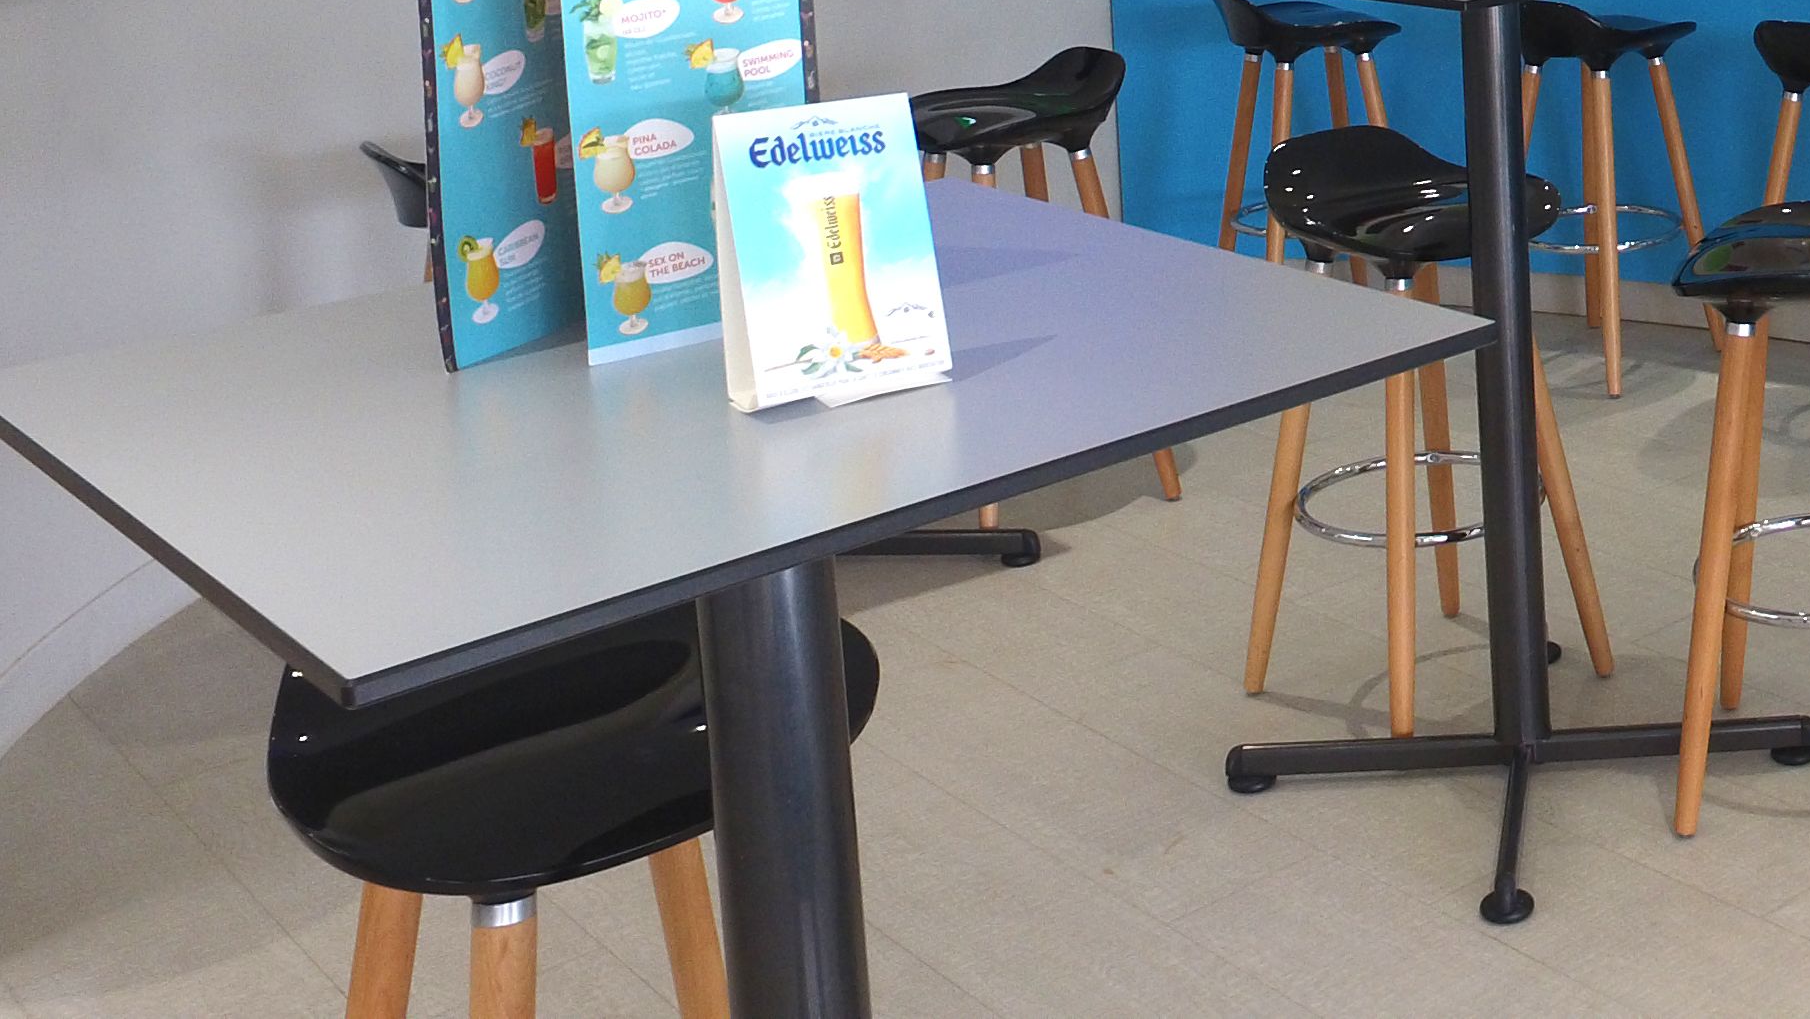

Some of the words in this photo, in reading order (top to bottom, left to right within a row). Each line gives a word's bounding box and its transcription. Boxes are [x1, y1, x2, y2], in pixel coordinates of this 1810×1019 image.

[742, 49, 794, 68] SWIMMING
[743, 65, 772, 78] POOL
[634, 140, 678, 156] COLADA
[748, 130, 887, 169] Edelweiss
[823, 196, 842, 249] Edelweiss
[648, 256, 665, 268] SEX
[668, 251, 685, 263] ON
[649, 265, 670, 278] THE
[672, 256, 706, 273] BEACH
